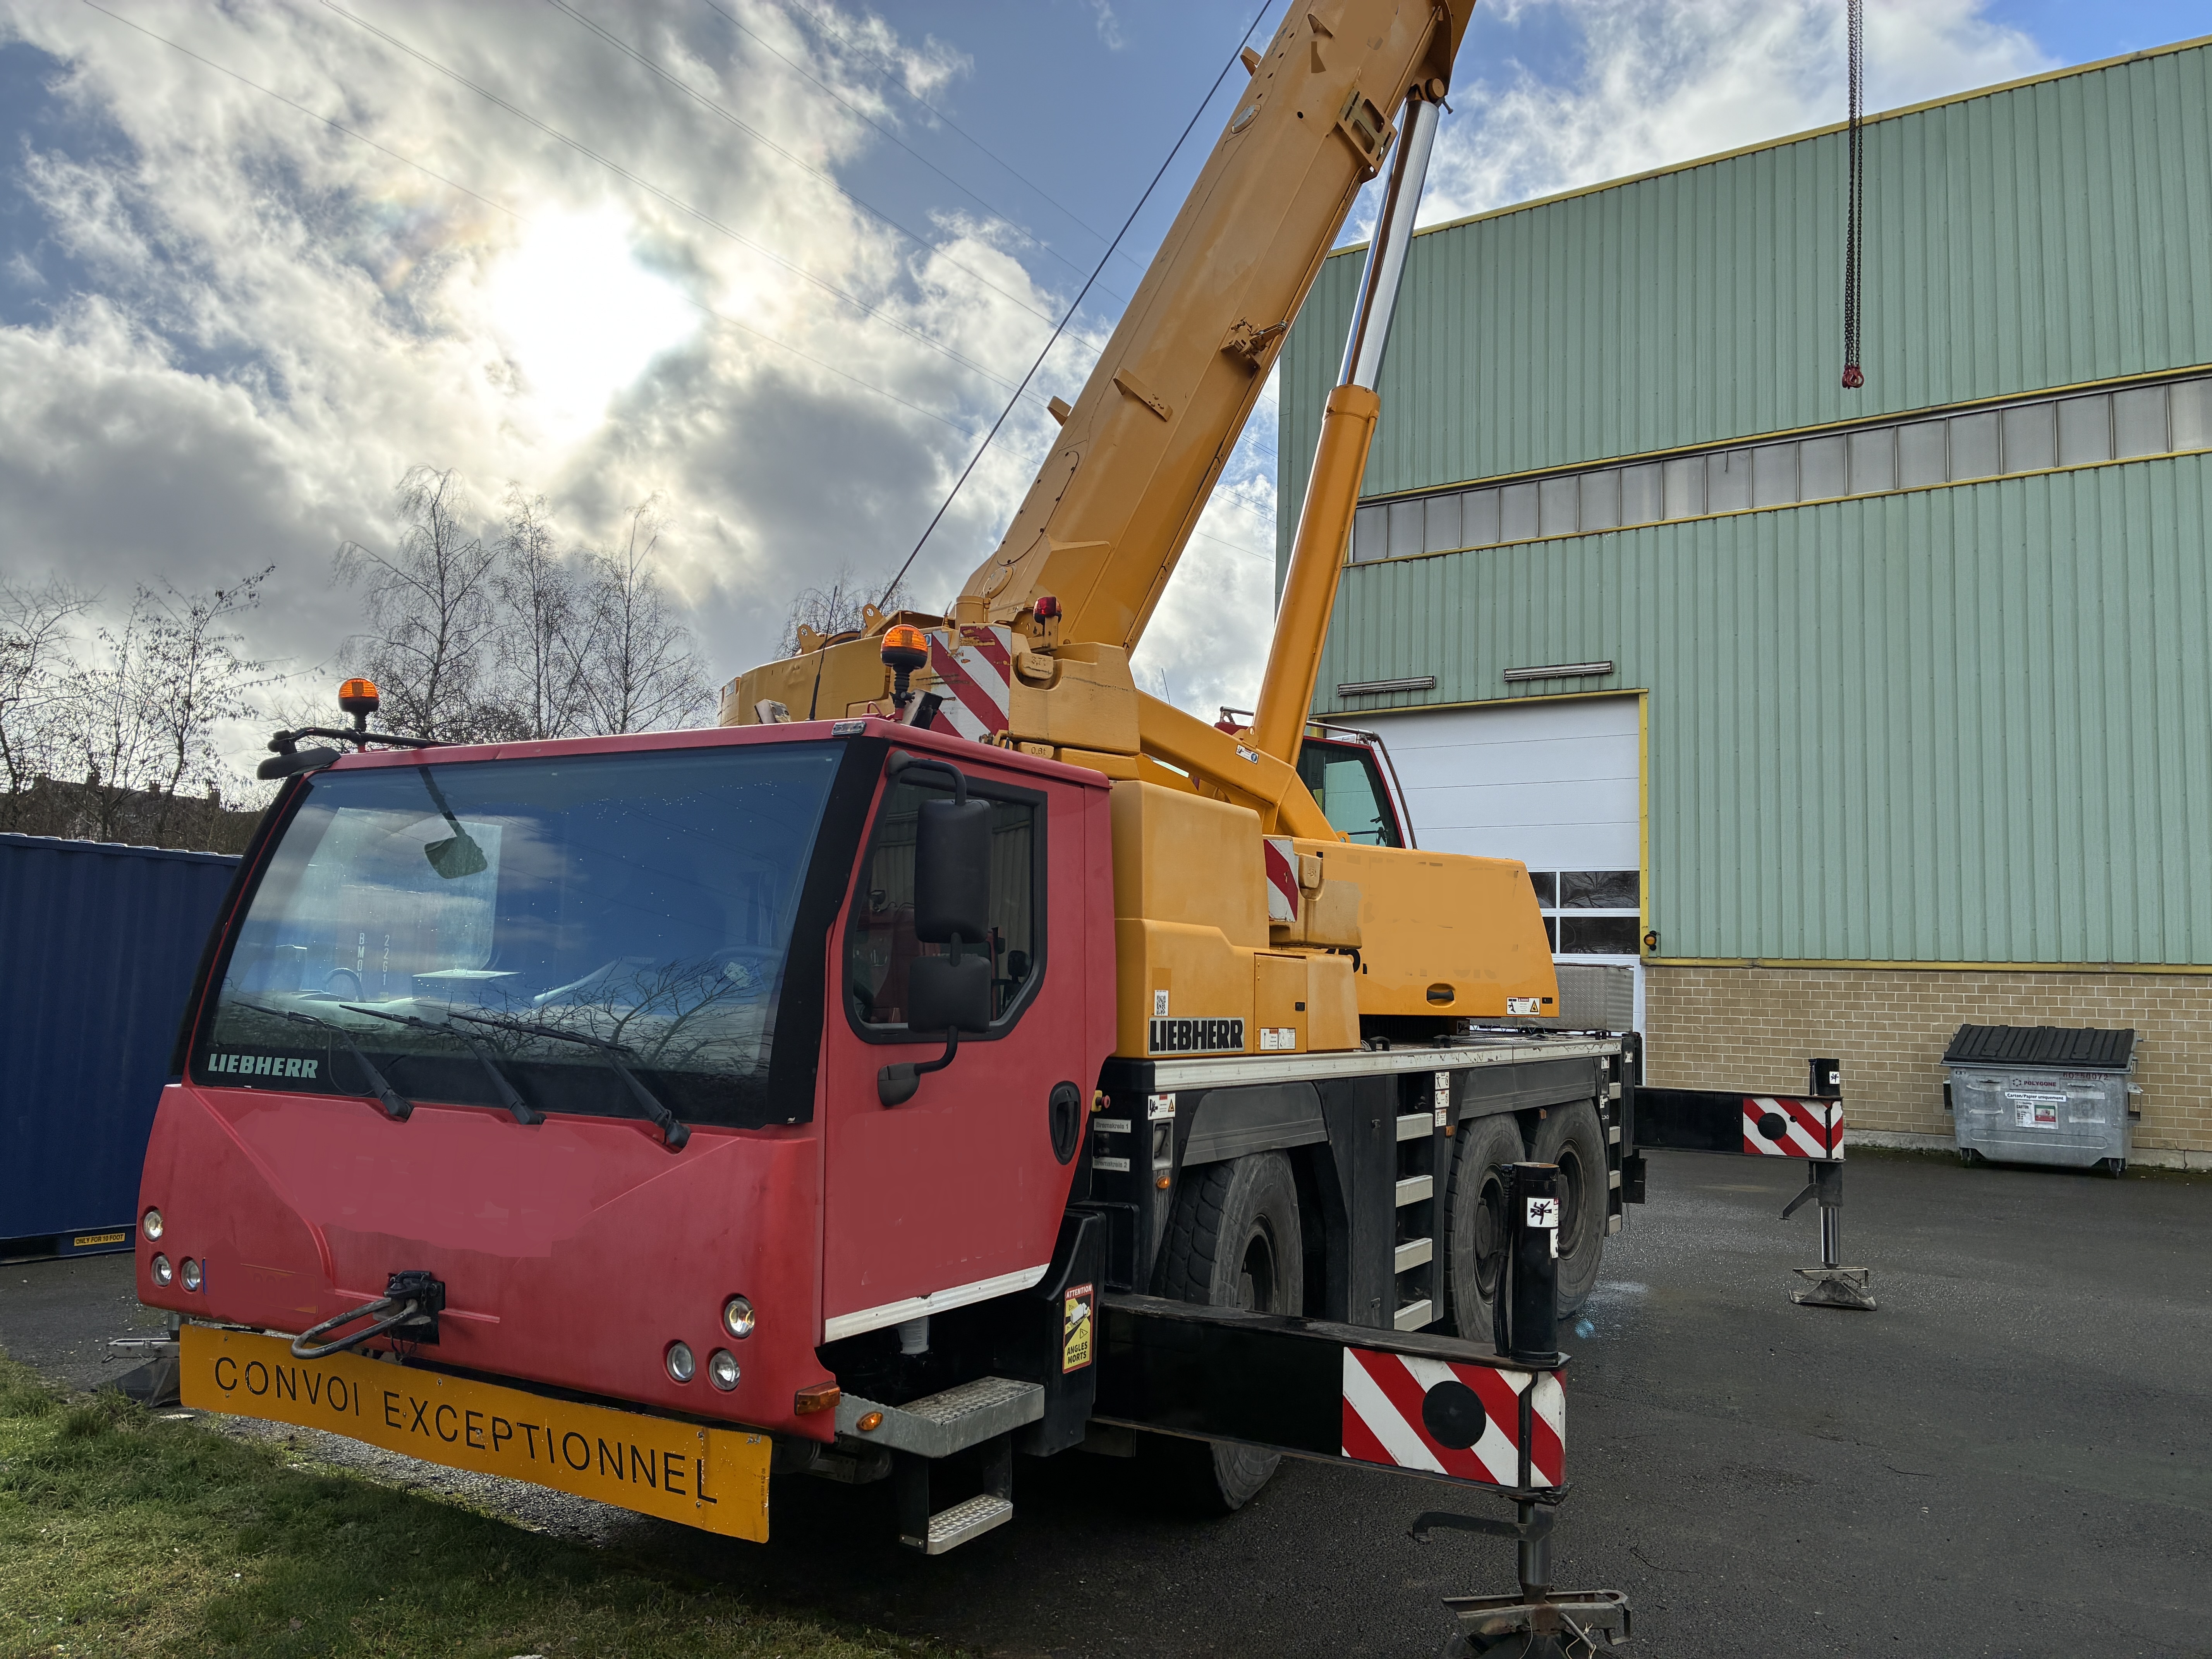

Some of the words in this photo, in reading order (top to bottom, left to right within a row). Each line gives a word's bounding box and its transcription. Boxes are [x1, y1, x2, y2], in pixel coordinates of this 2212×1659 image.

[1150, 1020, 1243, 1051] LIEBHERR
[208, 1054, 318, 1078] LIEBHERR
[1066, 1284, 1092, 1298] ATTENTION
[1067, 1341, 1087, 1356] ANGLES
[1068, 1351, 1086, 1364] MORTS
[214, 1357, 359, 1416] CONVOI
[384, 1390, 717, 1504] EXCEPTIONNEL
